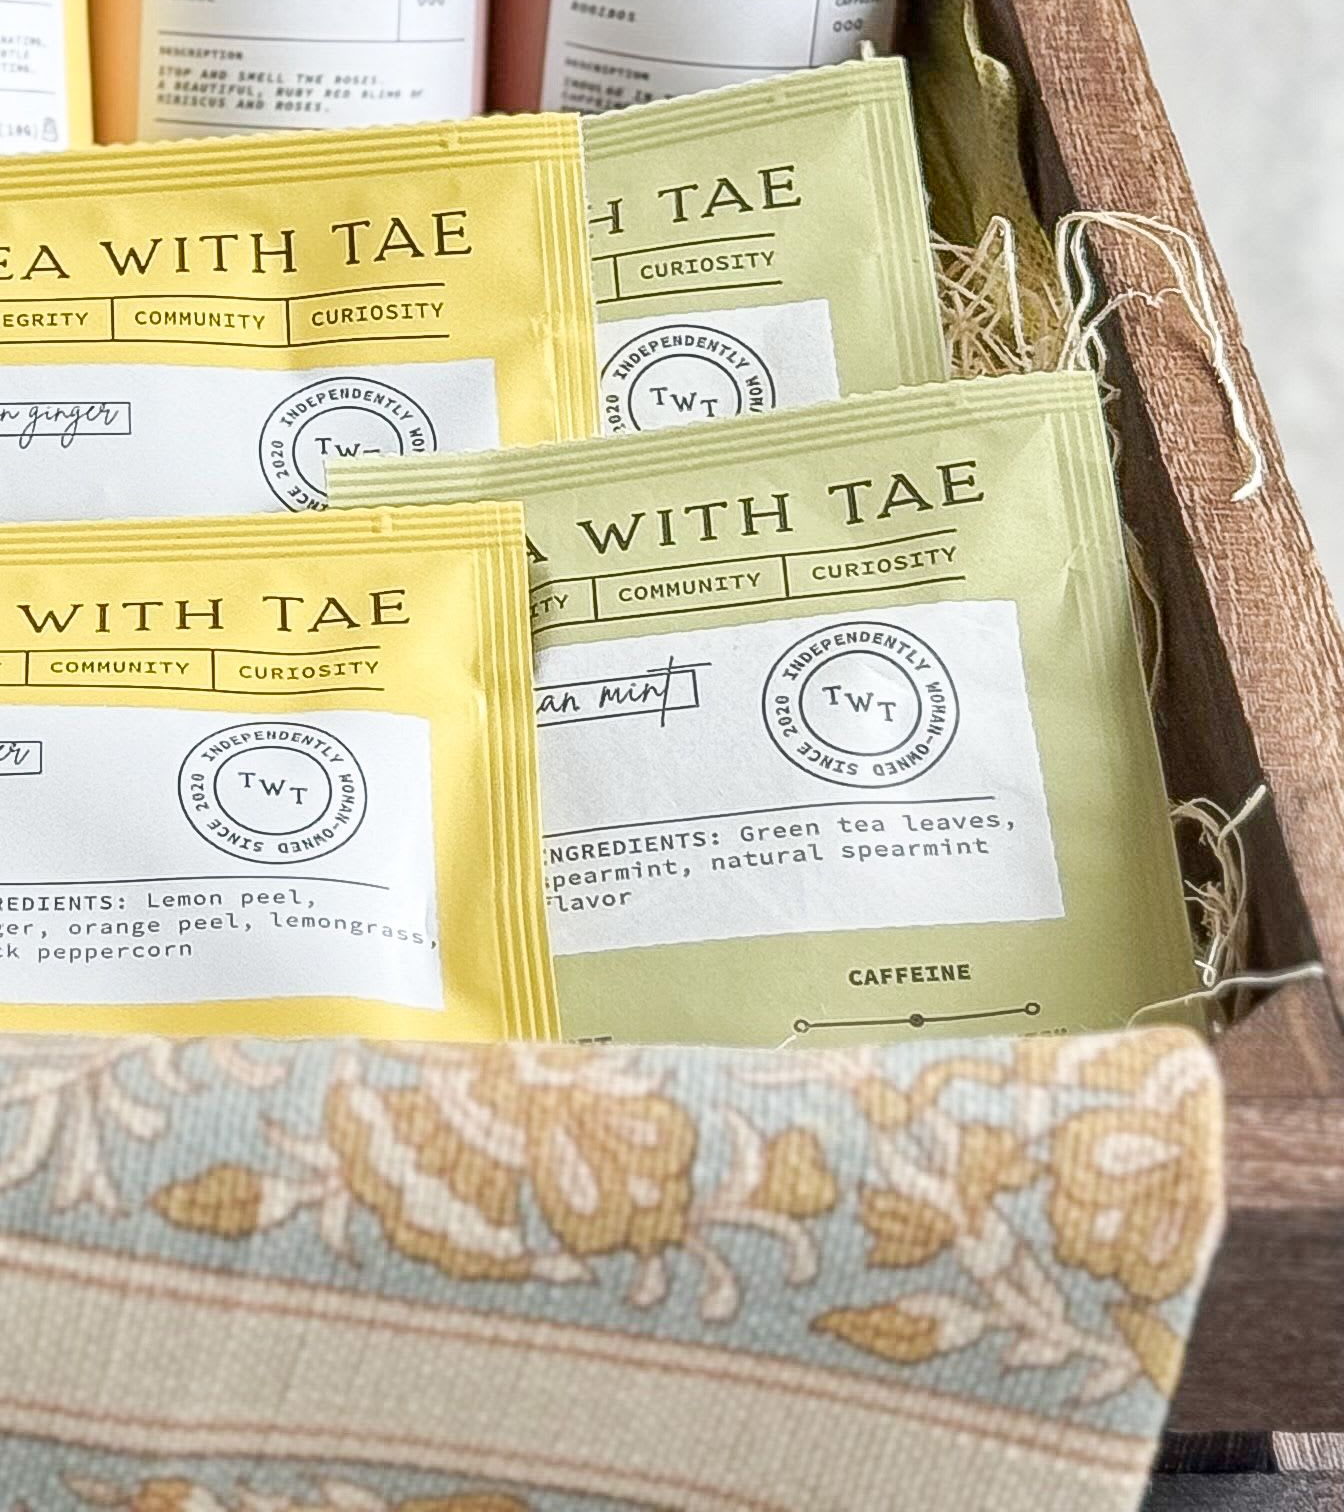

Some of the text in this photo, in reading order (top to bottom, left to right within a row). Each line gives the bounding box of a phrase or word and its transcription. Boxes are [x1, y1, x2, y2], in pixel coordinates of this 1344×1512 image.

[658, 165, 801, 223] TAE
[99, 229, 299, 277] WITH
[331, 209, 473, 266] TAE
[640, 251, 775, 280] CURIOSITY
[134, 310, 266, 330] COMMUNITY
[311, 302, 444, 327] CURIOSITY
[612, 335, 751, 380] INDEPENDENTLY
[280, 388, 414, 427] INDEPENDENTLY
[650, 386, 718, 417] TWT
[19, 404, 119, 450] ginger
[271, 440, 290, 479] 2020
[576, 492, 794, 555] WITH
[827, 460, 985, 526] TAE
[618, 546, 958, 603] COMMUNITY CURIOSITY
[17, 597, 224, 633] WITH
[262, 588, 411, 633] TAE
[50, 660, 190, 675] COMMUNITY
[239, 660, 380, 681] CURIOSITY
[782, 631, 932, 681] INDEPENDENTLY
[600, 655, 712, 727] mint
[822, 685, 896, 722] TWT
[201, 730, 344, 763] INDEPENDENTLY
[775, 695, 859, 776] SINCE 2020
[873, 681, 946, 777] WOMAN-OWNED
[237, 771, 309, 805] TWT
[190, 773, 264, 852] SINCE 2020
[278, 773, 355, 854] WOMAN-OWNED
[740, 820, 821, 844] Green
[838, 816, 885, 834] tea
[902, 813, 1015, 833] leaves,
[712, 843, 823, 871] natural
[841, 837, 990, 861] spearmint
[147, 890, 224, 908] Lemon
[240, 890, 316, 911] peel,
[68, 918, 161, 938] orange
[178, 912, 253, 934] peel,
[273, 911, 439, 950] lemongrass,
[37, 940, 193, 964] peppercorn
[849, 964, 972, 987] CAFFEINE
